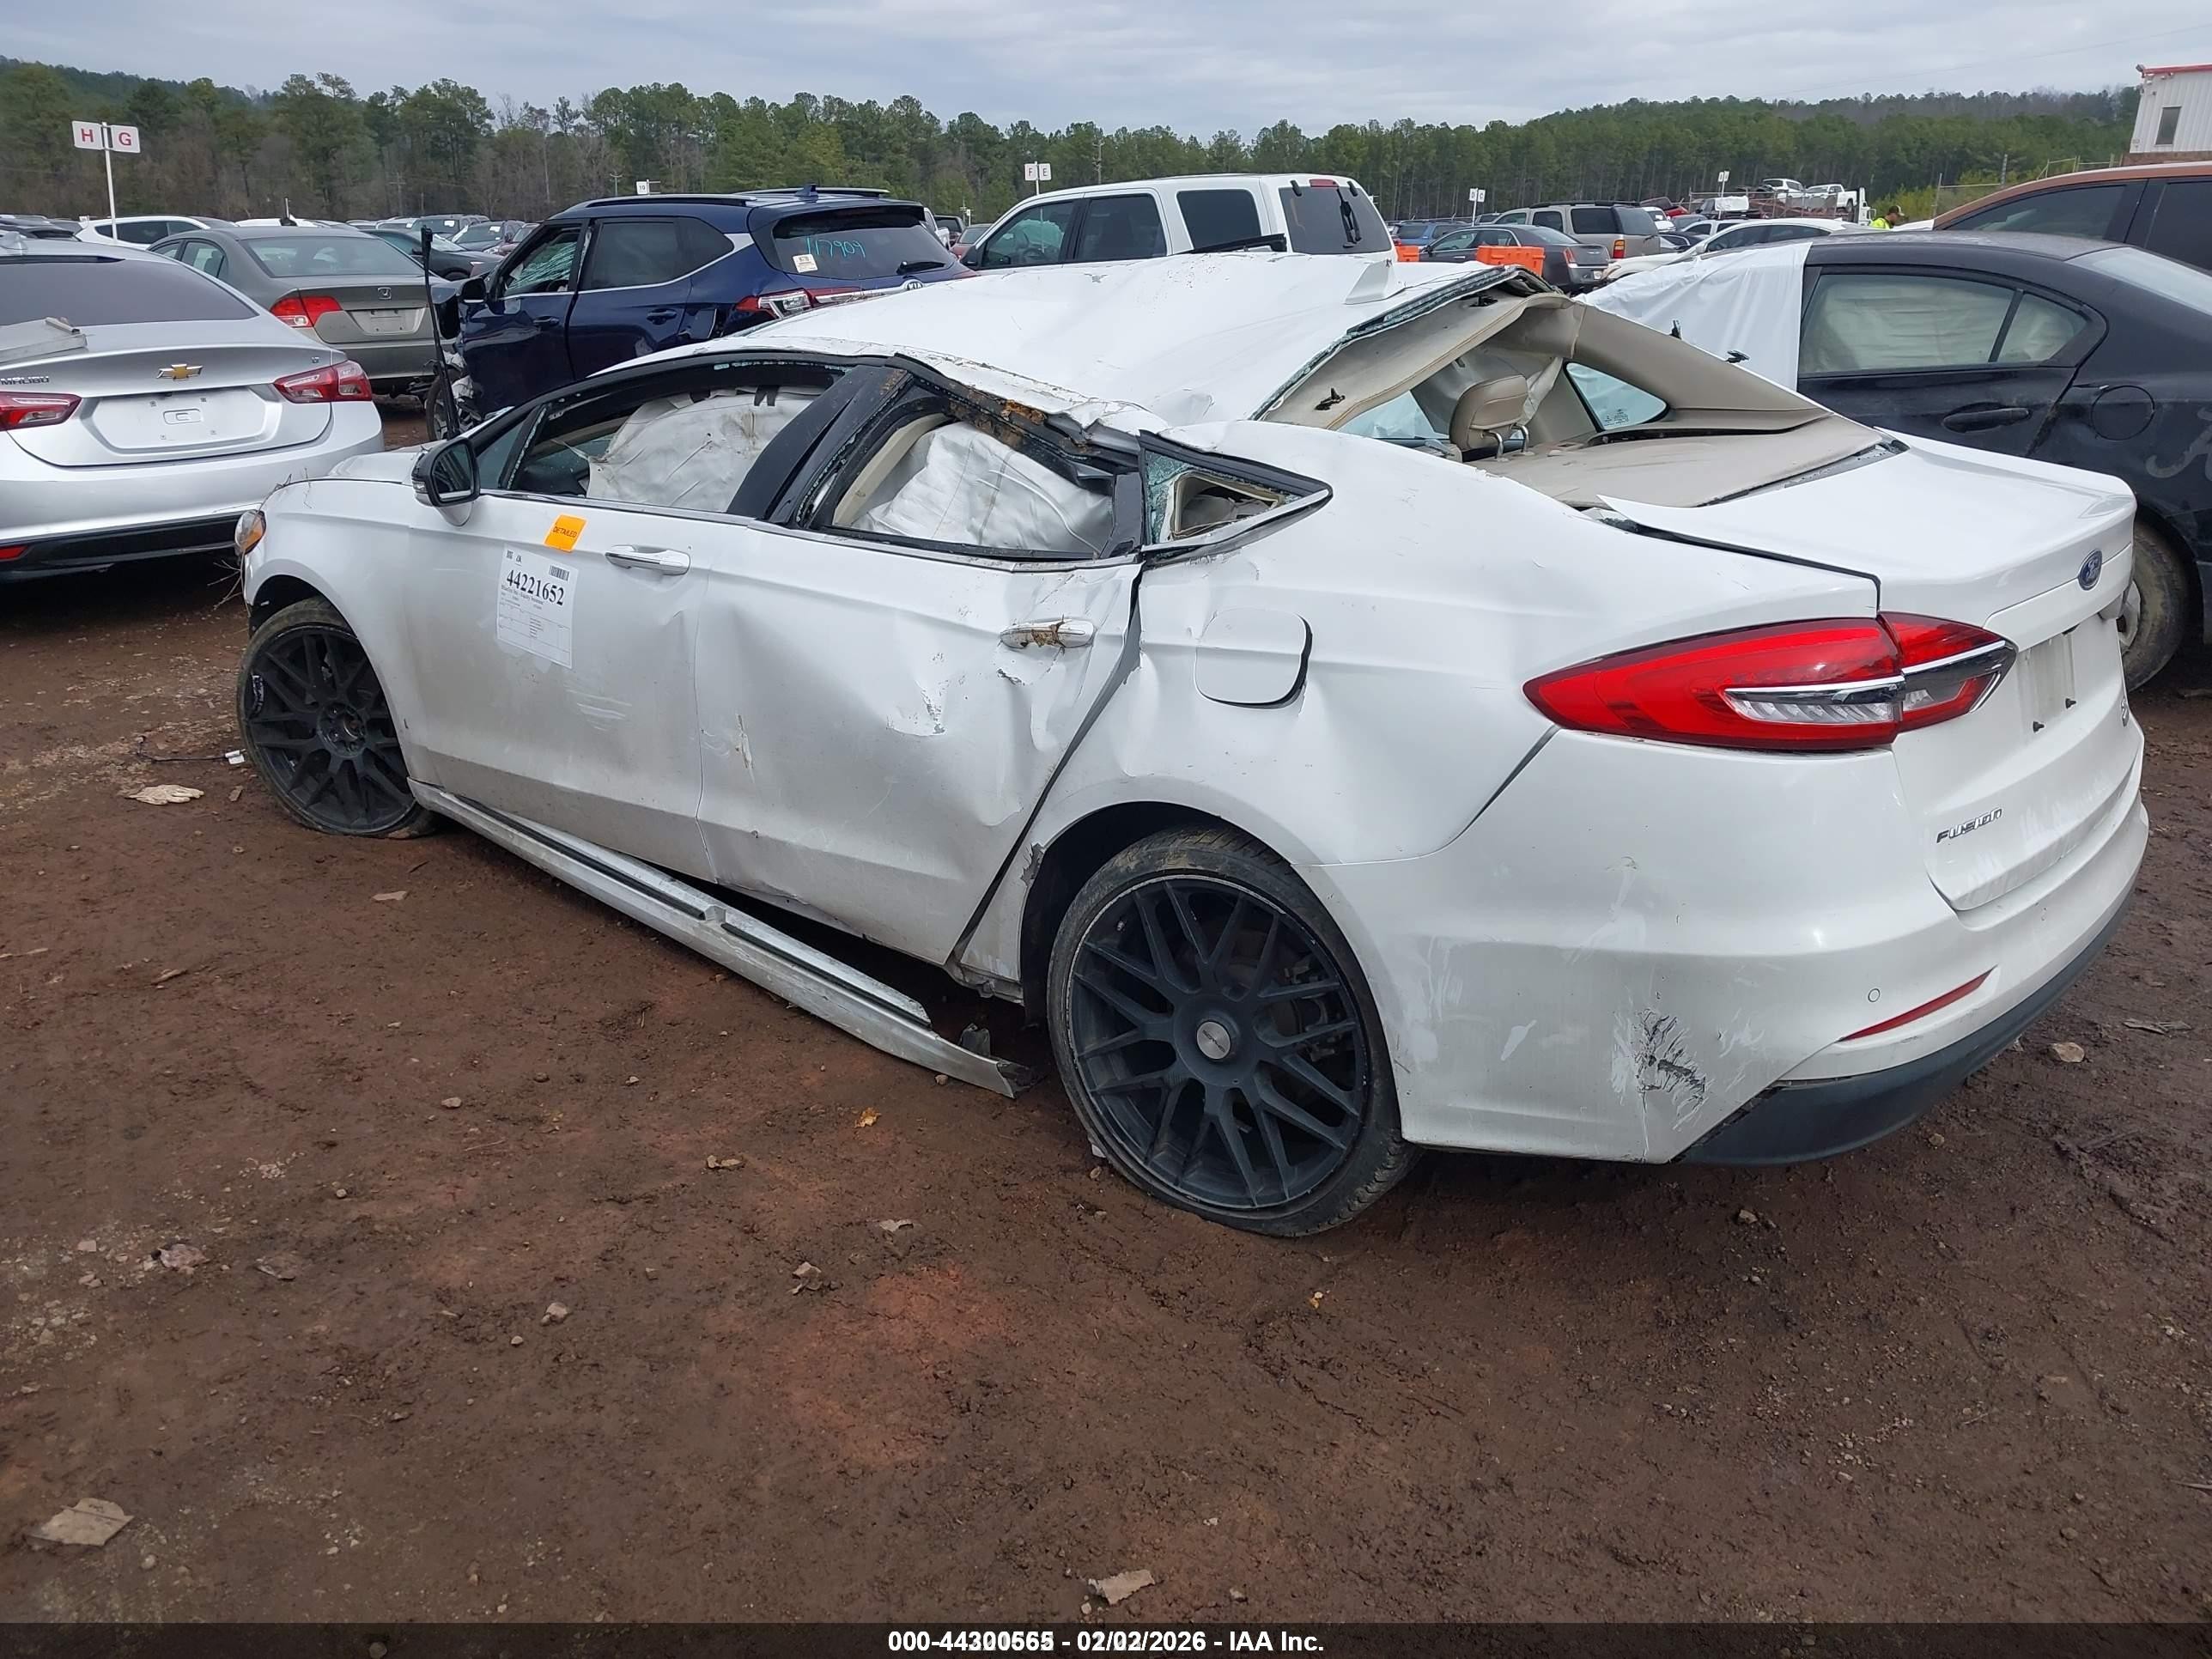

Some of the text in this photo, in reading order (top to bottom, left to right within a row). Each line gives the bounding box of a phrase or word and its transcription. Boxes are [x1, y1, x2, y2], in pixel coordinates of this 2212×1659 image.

[81, 128, 94, 143] H
[118, 131, 131, 146] G
[1028, 167, 1033, 177] F
[1042, 167, 1048, 177] E
[807, 237, 866, 258] 117909
[906, 282, 923, 290] KIA
[0, 376, 50, 386] MALIBU
[506, 569, 564, 606] 44221652
